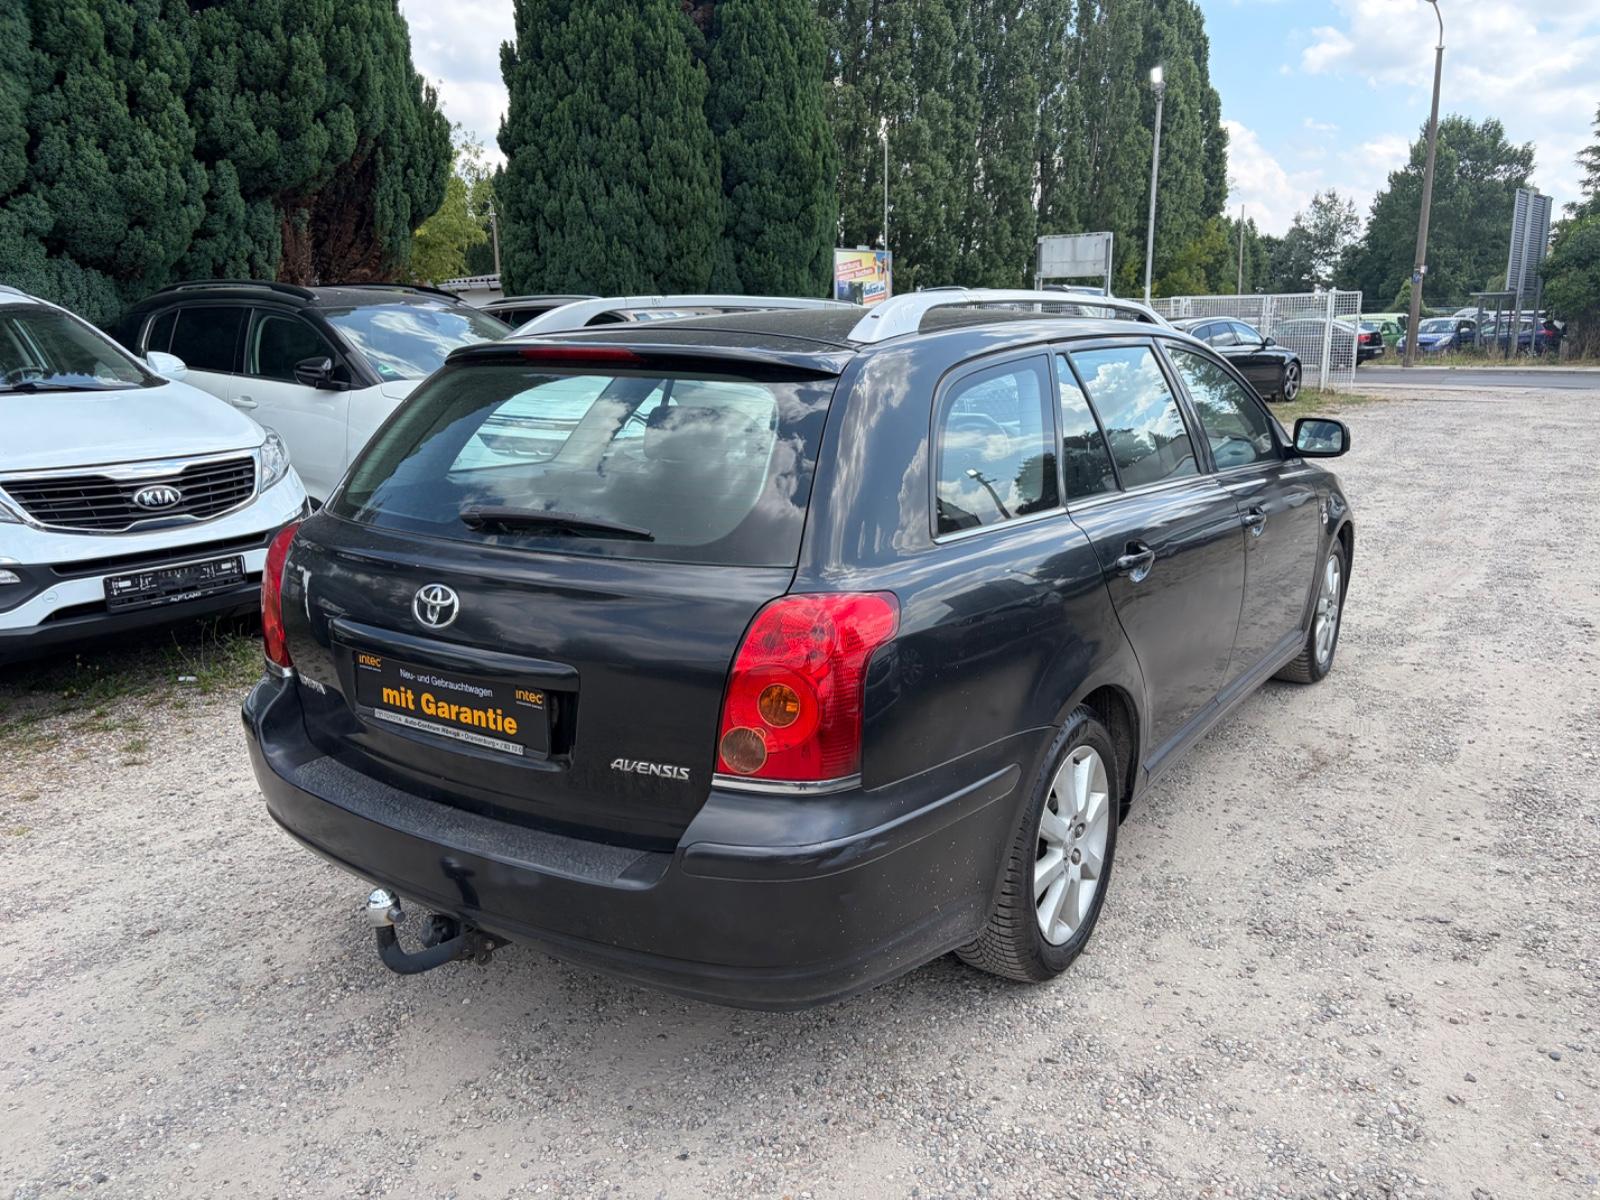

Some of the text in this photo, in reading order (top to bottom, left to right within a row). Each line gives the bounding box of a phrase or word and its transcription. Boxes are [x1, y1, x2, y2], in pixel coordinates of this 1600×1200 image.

[142, 491, 176, 505] KIA
[359, 654, 381, 668] intec
[399, 668, 493, 698] Neu- und Gebrauchtwagen
[515, 688, 543, 704] intec
[382, 687, 518, 735] mit Garantie
[610, 758, 690, 780] AVENSIS
